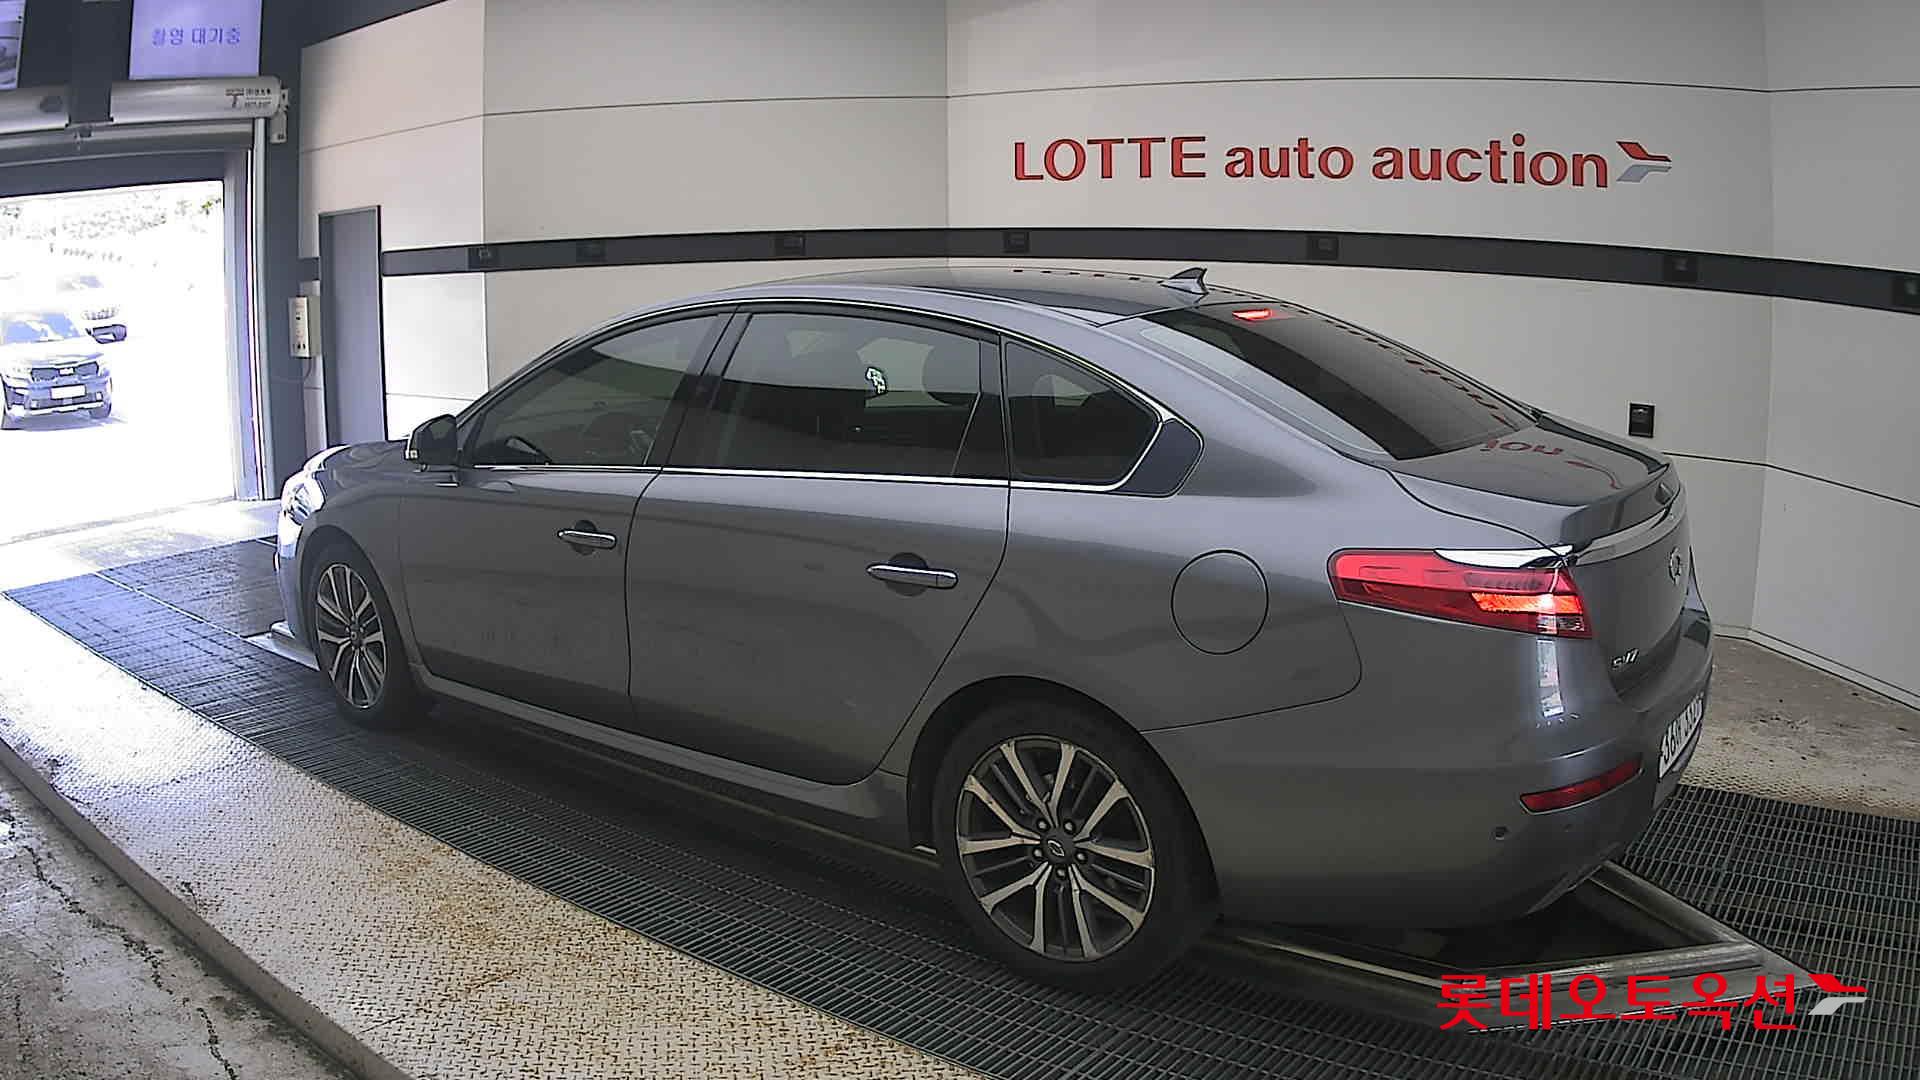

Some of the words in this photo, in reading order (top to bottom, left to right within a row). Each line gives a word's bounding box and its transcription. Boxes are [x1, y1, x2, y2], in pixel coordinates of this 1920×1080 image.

[191, 27, 241, 46] 대기중
[1014, 136, 1206, 181] LOTTE
[1224, 137, 1355, 180] auto
[1371, 134, 1609, 188] auction
